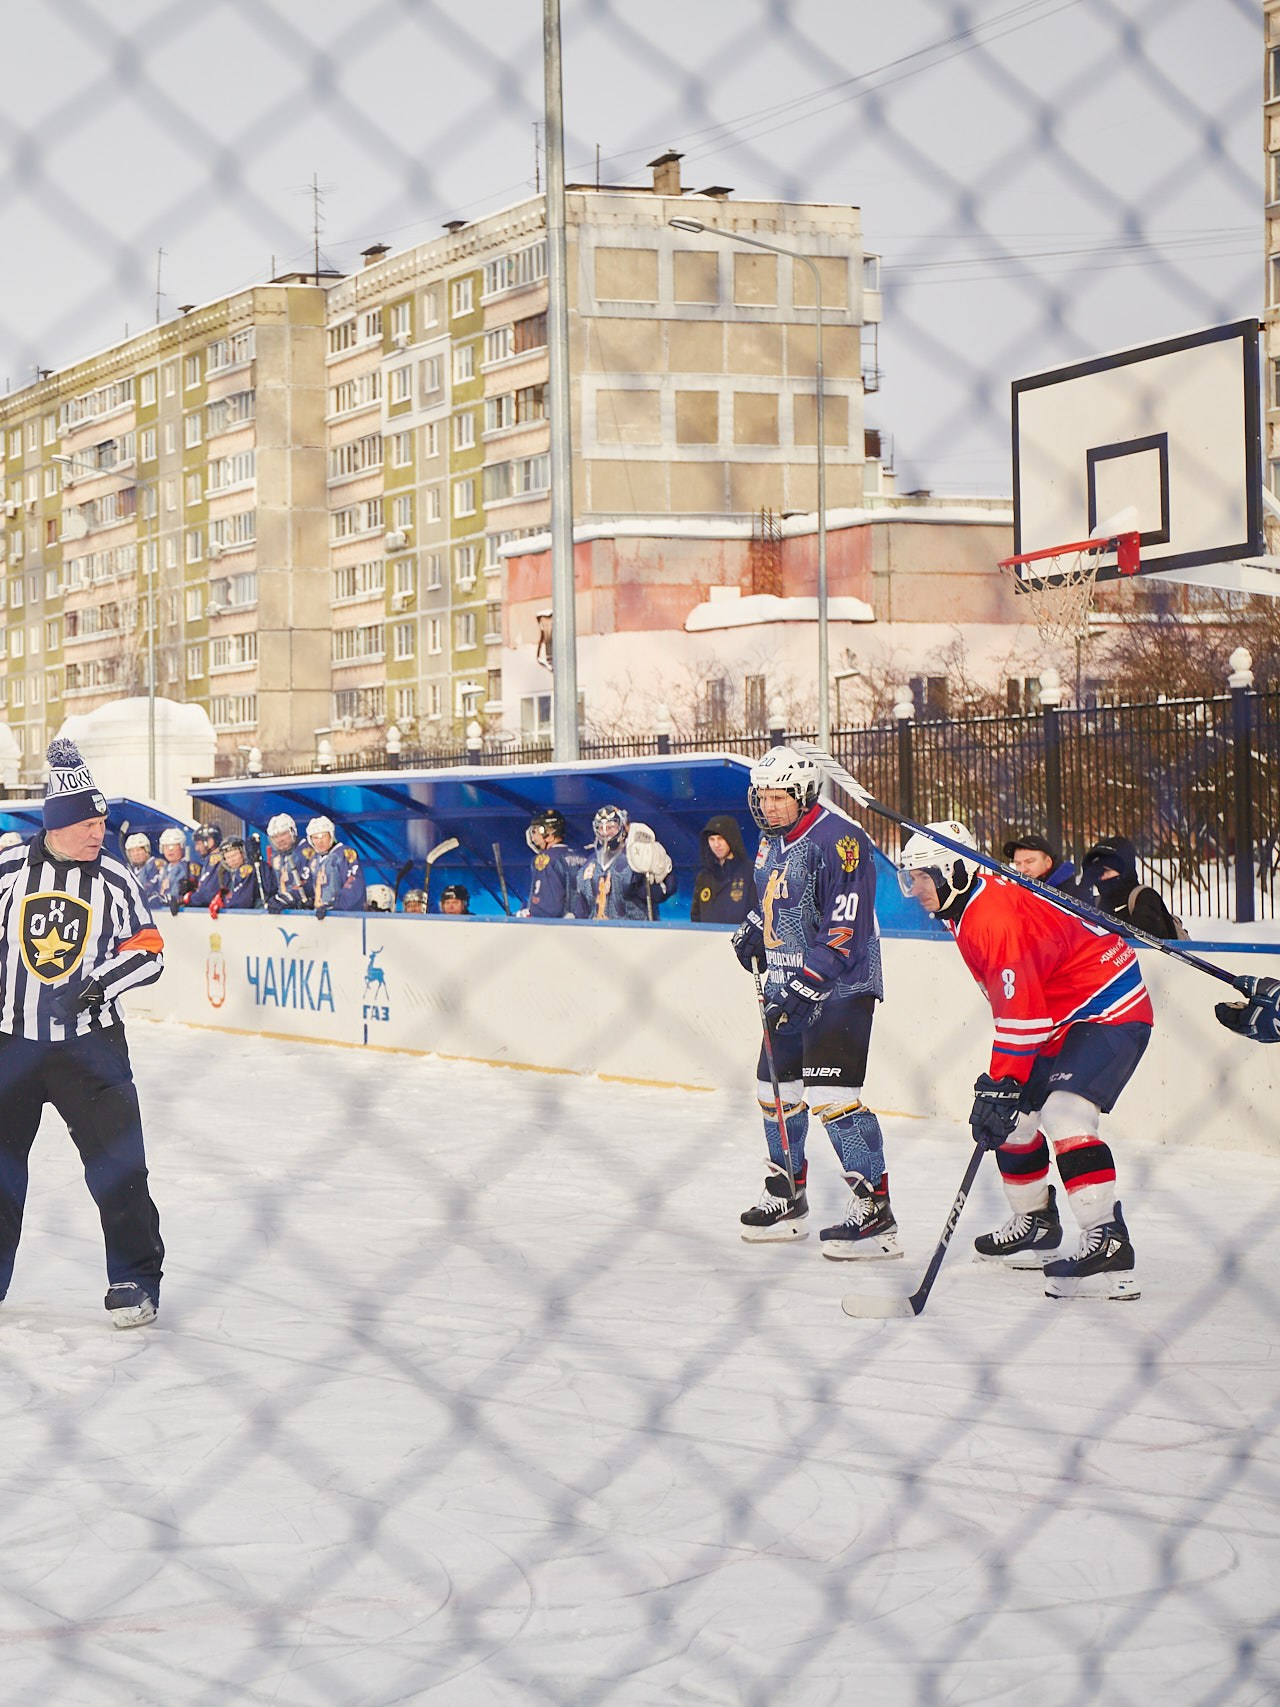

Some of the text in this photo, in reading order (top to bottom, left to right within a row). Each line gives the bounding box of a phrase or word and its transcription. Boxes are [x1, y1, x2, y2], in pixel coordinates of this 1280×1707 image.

[831, 892, 860, 922] 20
[1001, 968, 1016, 1000] 8
[362, 1004, 390, 1022] ГАЗ
